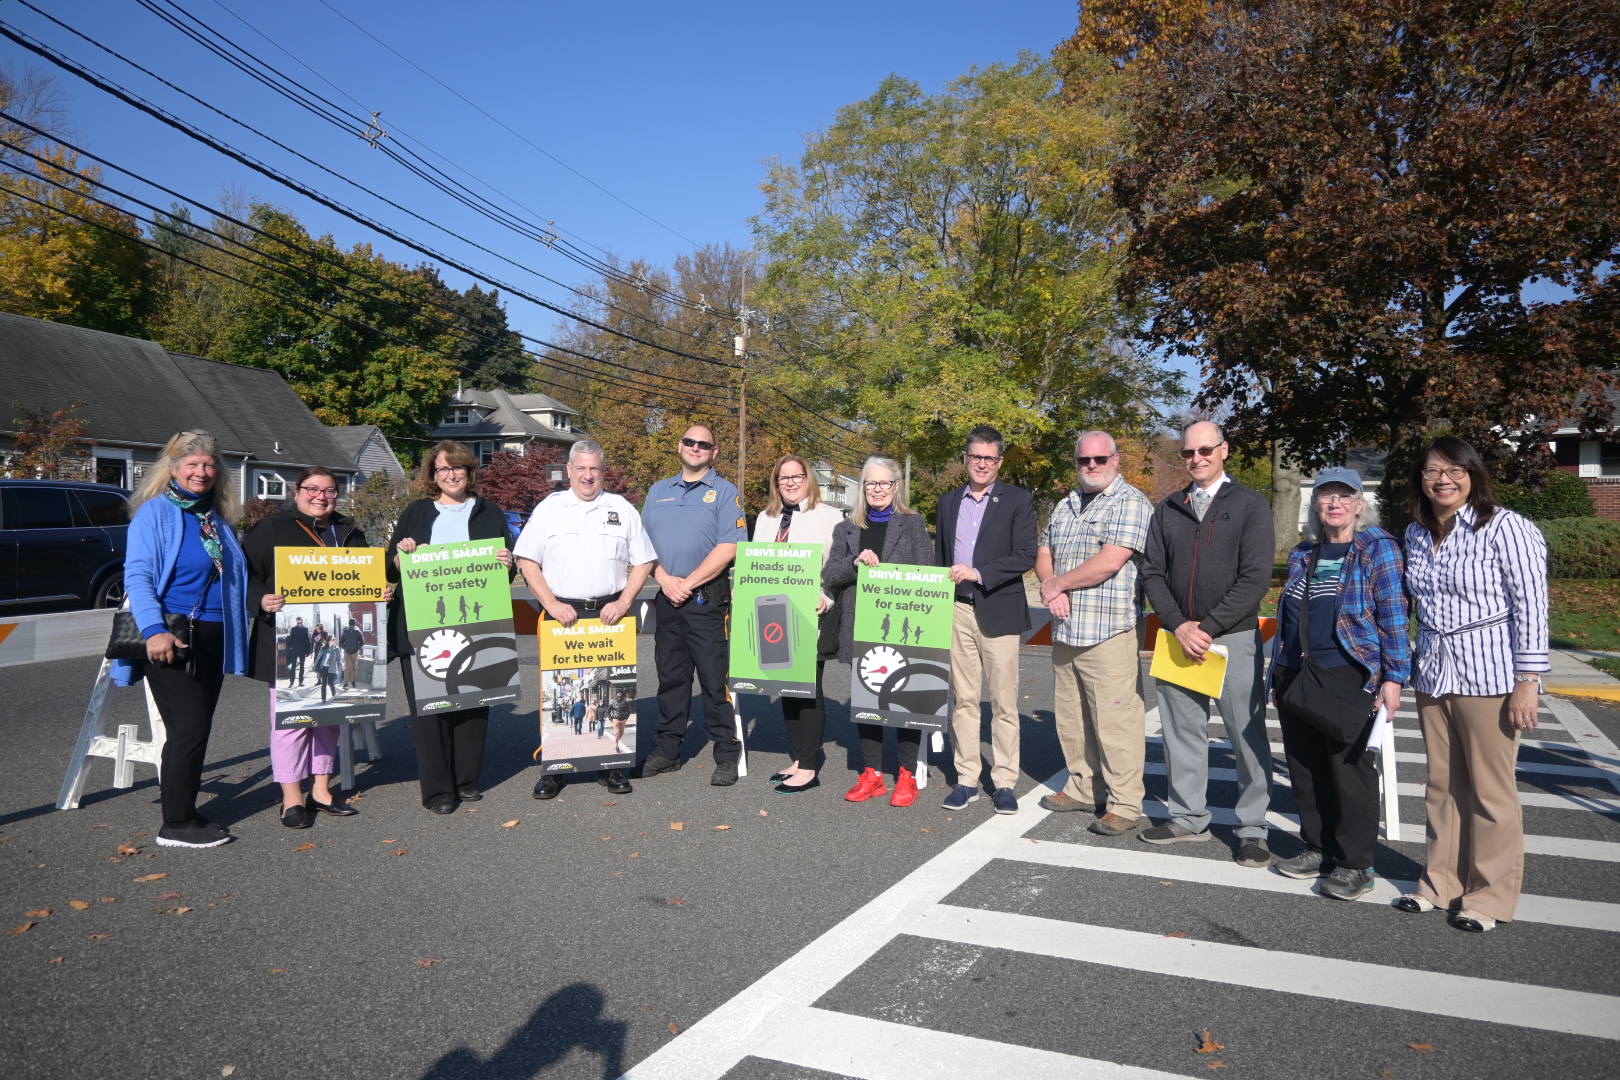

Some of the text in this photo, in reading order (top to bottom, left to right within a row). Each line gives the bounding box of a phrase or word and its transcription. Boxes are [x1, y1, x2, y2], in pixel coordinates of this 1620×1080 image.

[412, 546, 494, 563] DRIVE SMART
[746, 549, 812, 558] DRIVE SMART
[288, 555, 373, 565] WALK SMART
[407, 562, 502, 579] We slow down
[751, 562, 804, 573] Heads up,
[304, 570, 360, 581] We look
[740, 576, 813, 586] phones down
[868, 570, 945, 583] DRIVE SMART
[425, 578, 488, 592] for safety
[281, 585, 382, 598] before crossing
[862, 584, 949, 599] We slow down
[875, 599, 932, 614] for safety
[552, 624, 626, 636] WALK SMART
[565, 638, 614, 649] We wait
[553, 652, 625, 664] for the walk
